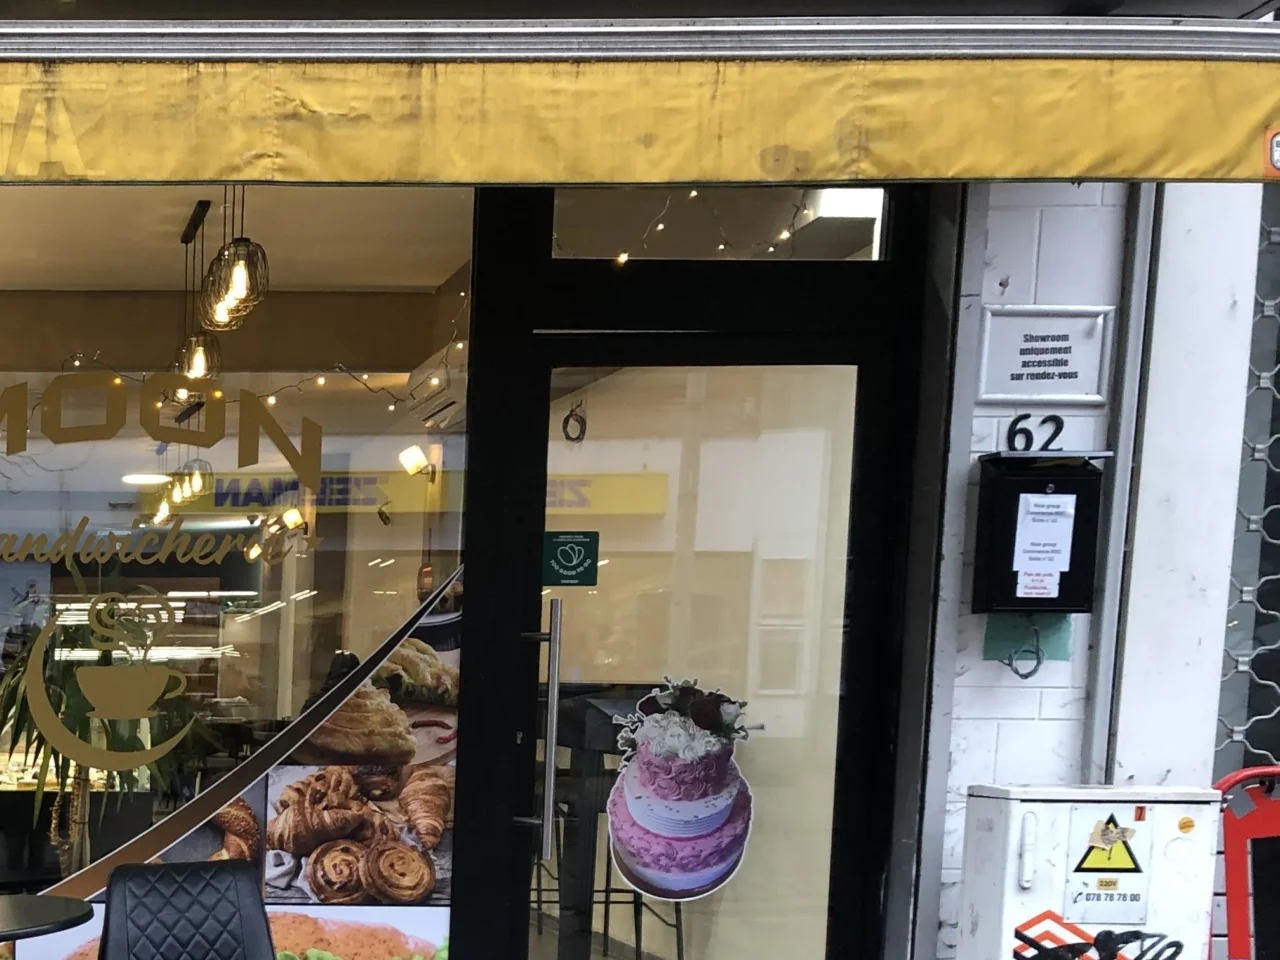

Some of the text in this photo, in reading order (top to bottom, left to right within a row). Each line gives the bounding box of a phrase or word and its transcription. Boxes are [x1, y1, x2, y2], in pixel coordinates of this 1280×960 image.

[1023, 333, 1069, 343] Showroom
[1019, 345, 1072, 357] uniquement
[1021, 357, 1069, 368] accessible
[1010, 370, 1078, 381] sur rendez-vous
[1007, 413, 1066, 452] 62
[1085, 893, 1141, 902] 078 78 78 00
